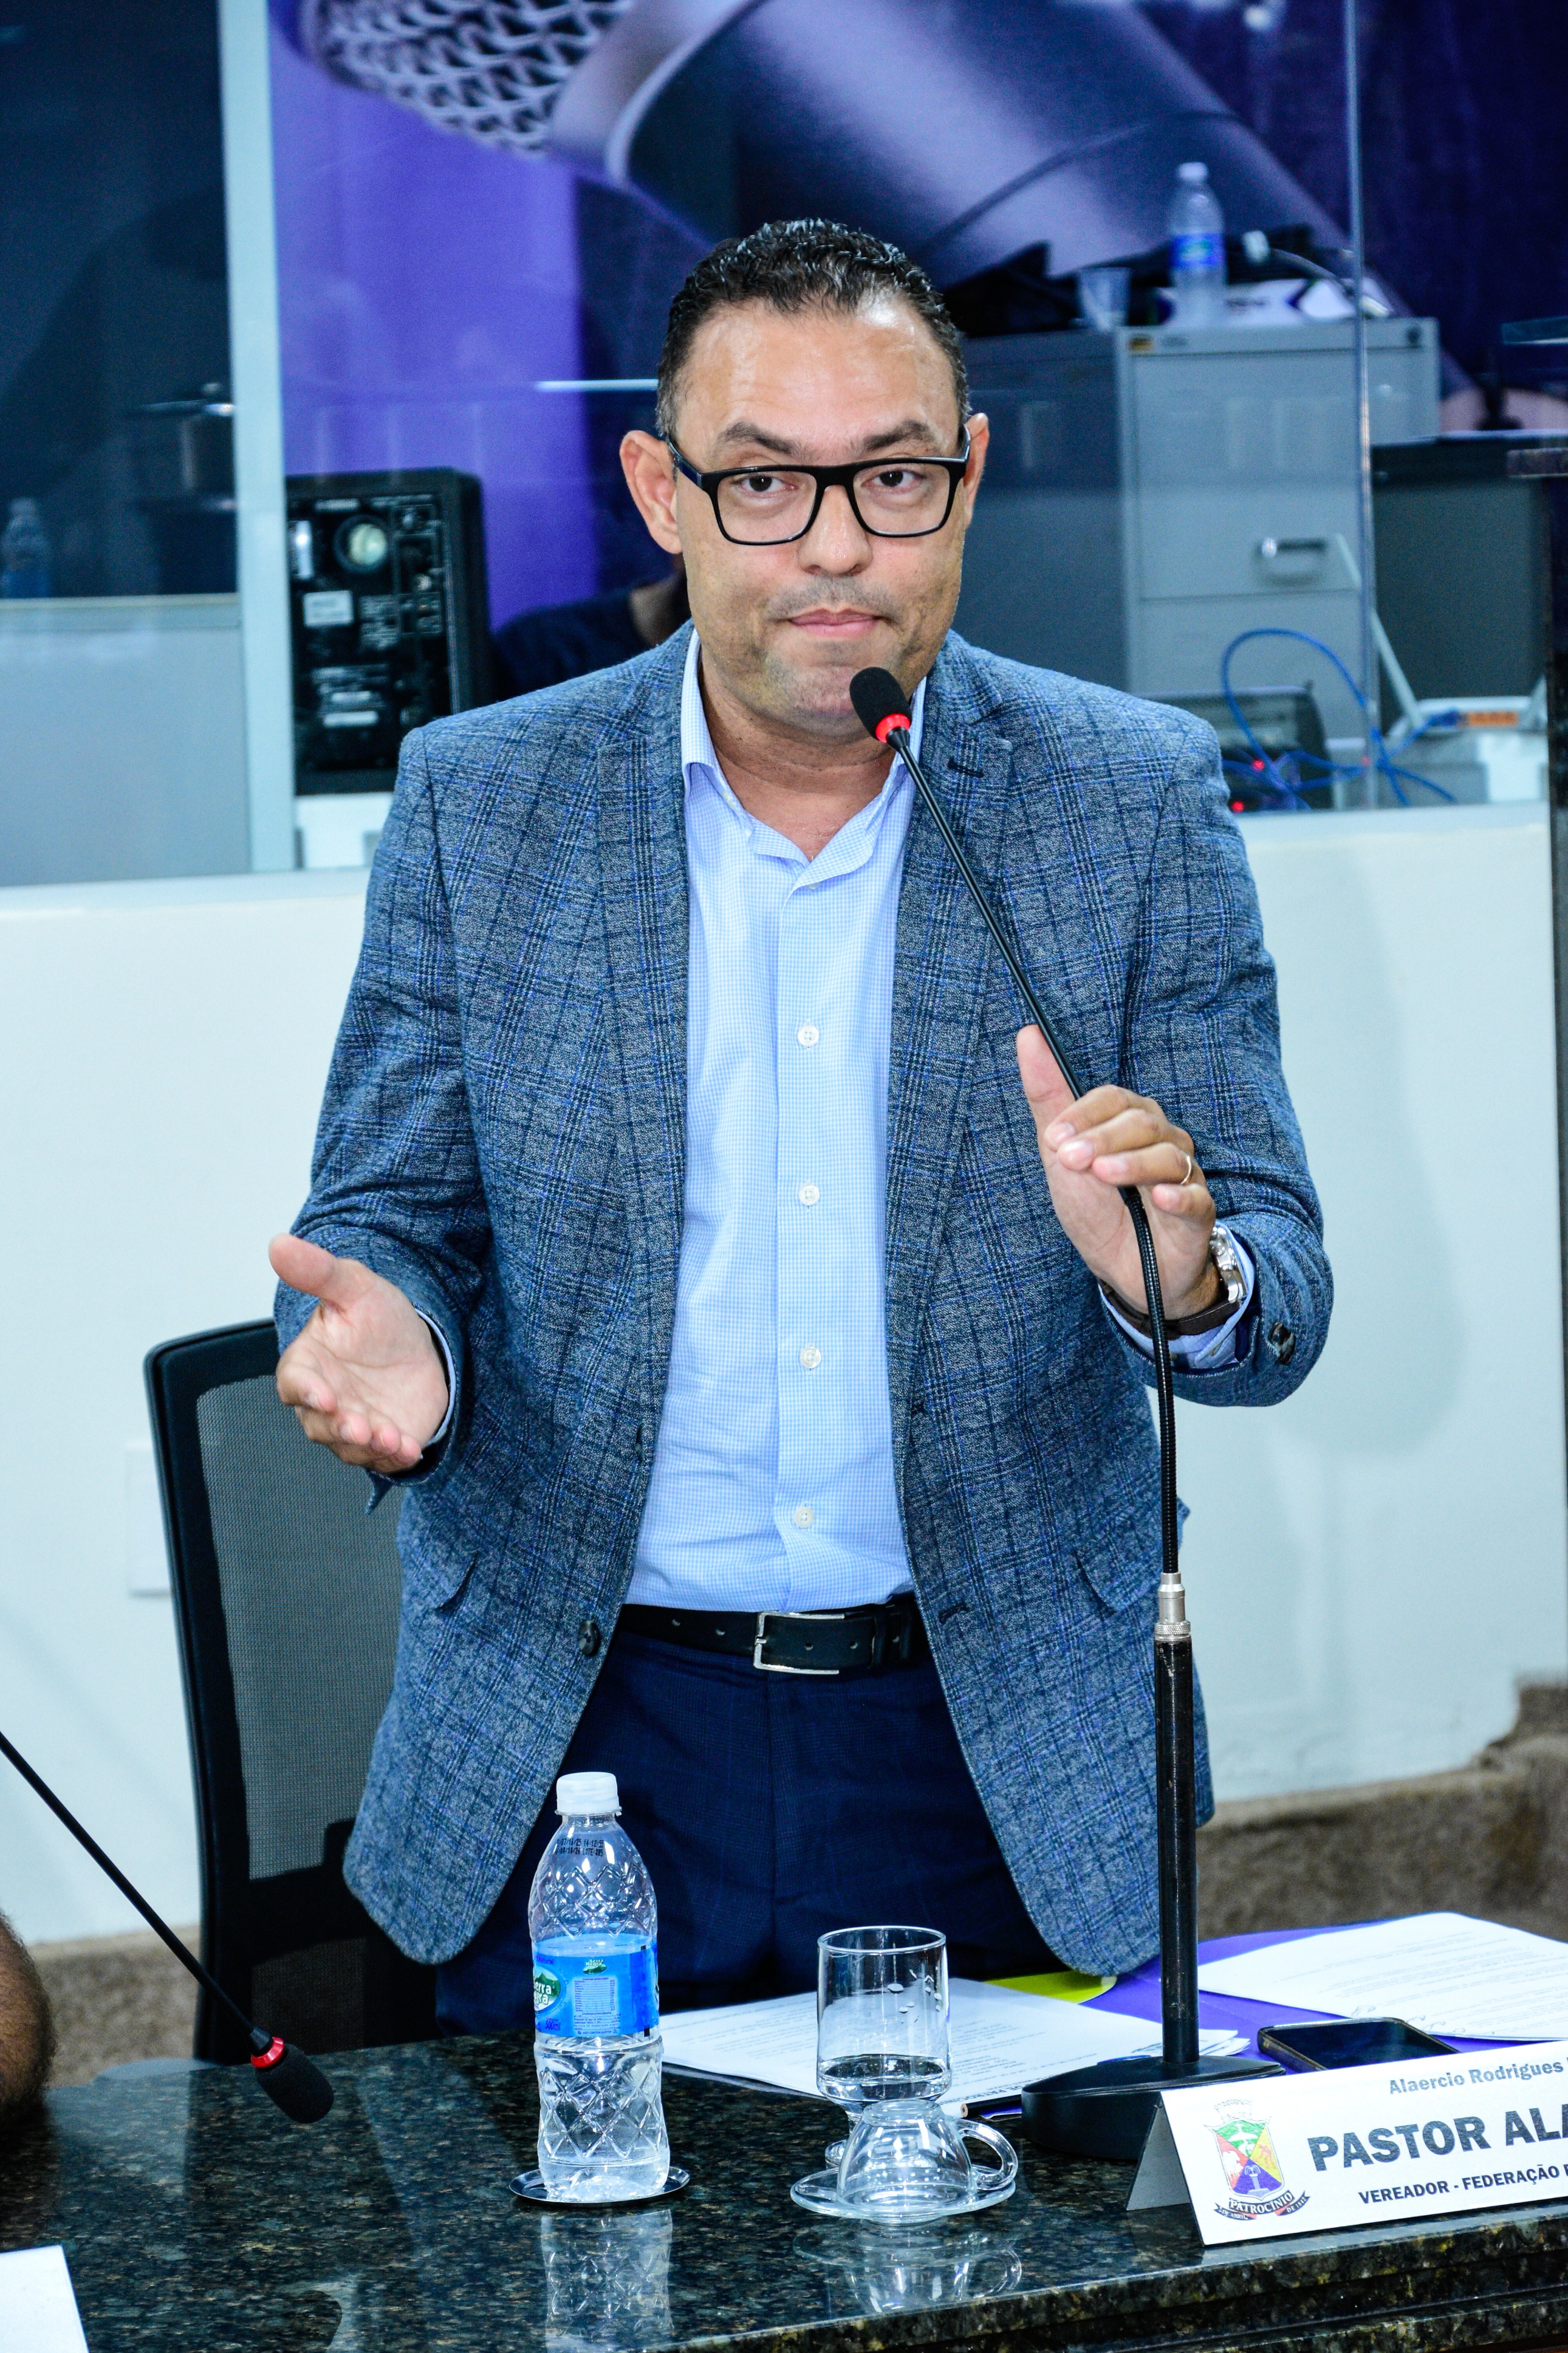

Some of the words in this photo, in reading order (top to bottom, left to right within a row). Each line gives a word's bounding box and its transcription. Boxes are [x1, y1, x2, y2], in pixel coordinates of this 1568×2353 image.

[533, 1981, 552, 1995] erra
[533, 1991, 549, 2005] egra
[546, 2020, 561, 2032] 500ml
[1389, 2072, 1465, 2094] Alaercio
[1468, 2061, 1564, 2083] Rodrigues
[1307, 2116, 1492, 2172] PASTOR
[1505, 2104, 1568, 2146] AL
[1358, 2180, 1451, 2205] VEREADOR
[1462, 2164, 1561, 2191] FEDERAÇÃO
